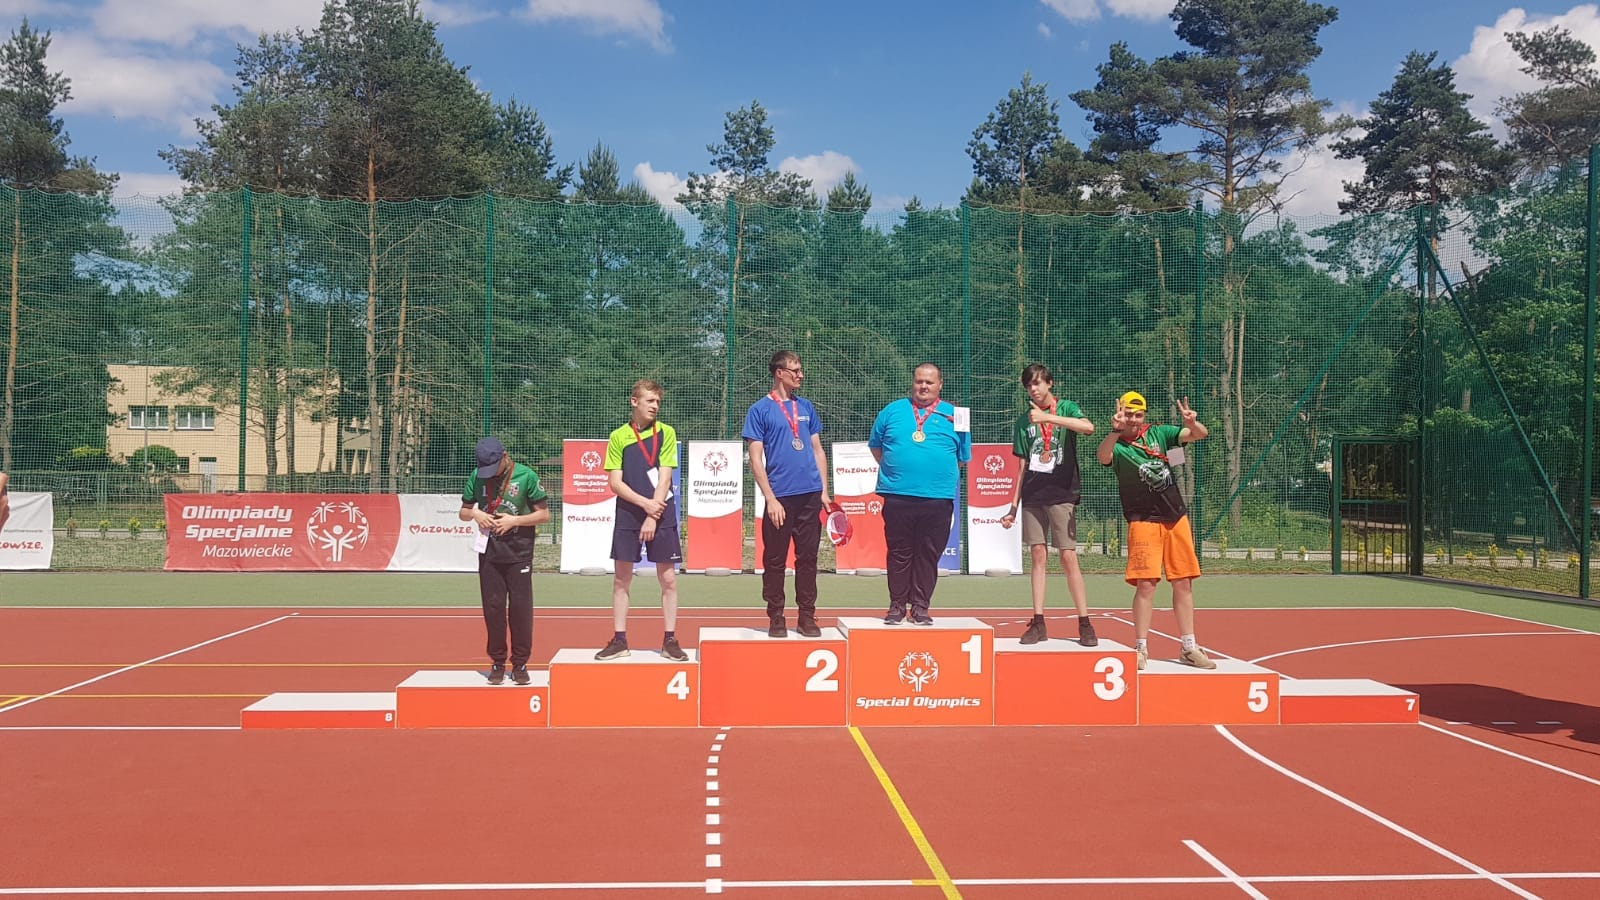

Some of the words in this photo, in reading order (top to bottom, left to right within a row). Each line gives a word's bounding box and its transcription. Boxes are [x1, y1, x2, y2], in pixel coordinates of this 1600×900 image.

[693, 480, 738, 488] Olimpiady
[693, 488, 738, 496] Specjalne
[182, 505, 293, 523] Olimpiady
[185, 524, 293, 542] Specjalne
[202, 543, 293, 558] Mazowieckie
[961, 635, 982, 674] 1
[805, 650, 839, 692] 2
[1093, 657, 1126, 701] 3
[667, 671, 690, 700] 4
[529, 695, 541, 713] 6
[856, 696, 910, 709] Special
[913, 696, 981, 709] Olympics
[1247, 681, 1269, 713] 5
[1405, 699, 1416, 711] 7
[384, 712, 393, 722] 8
